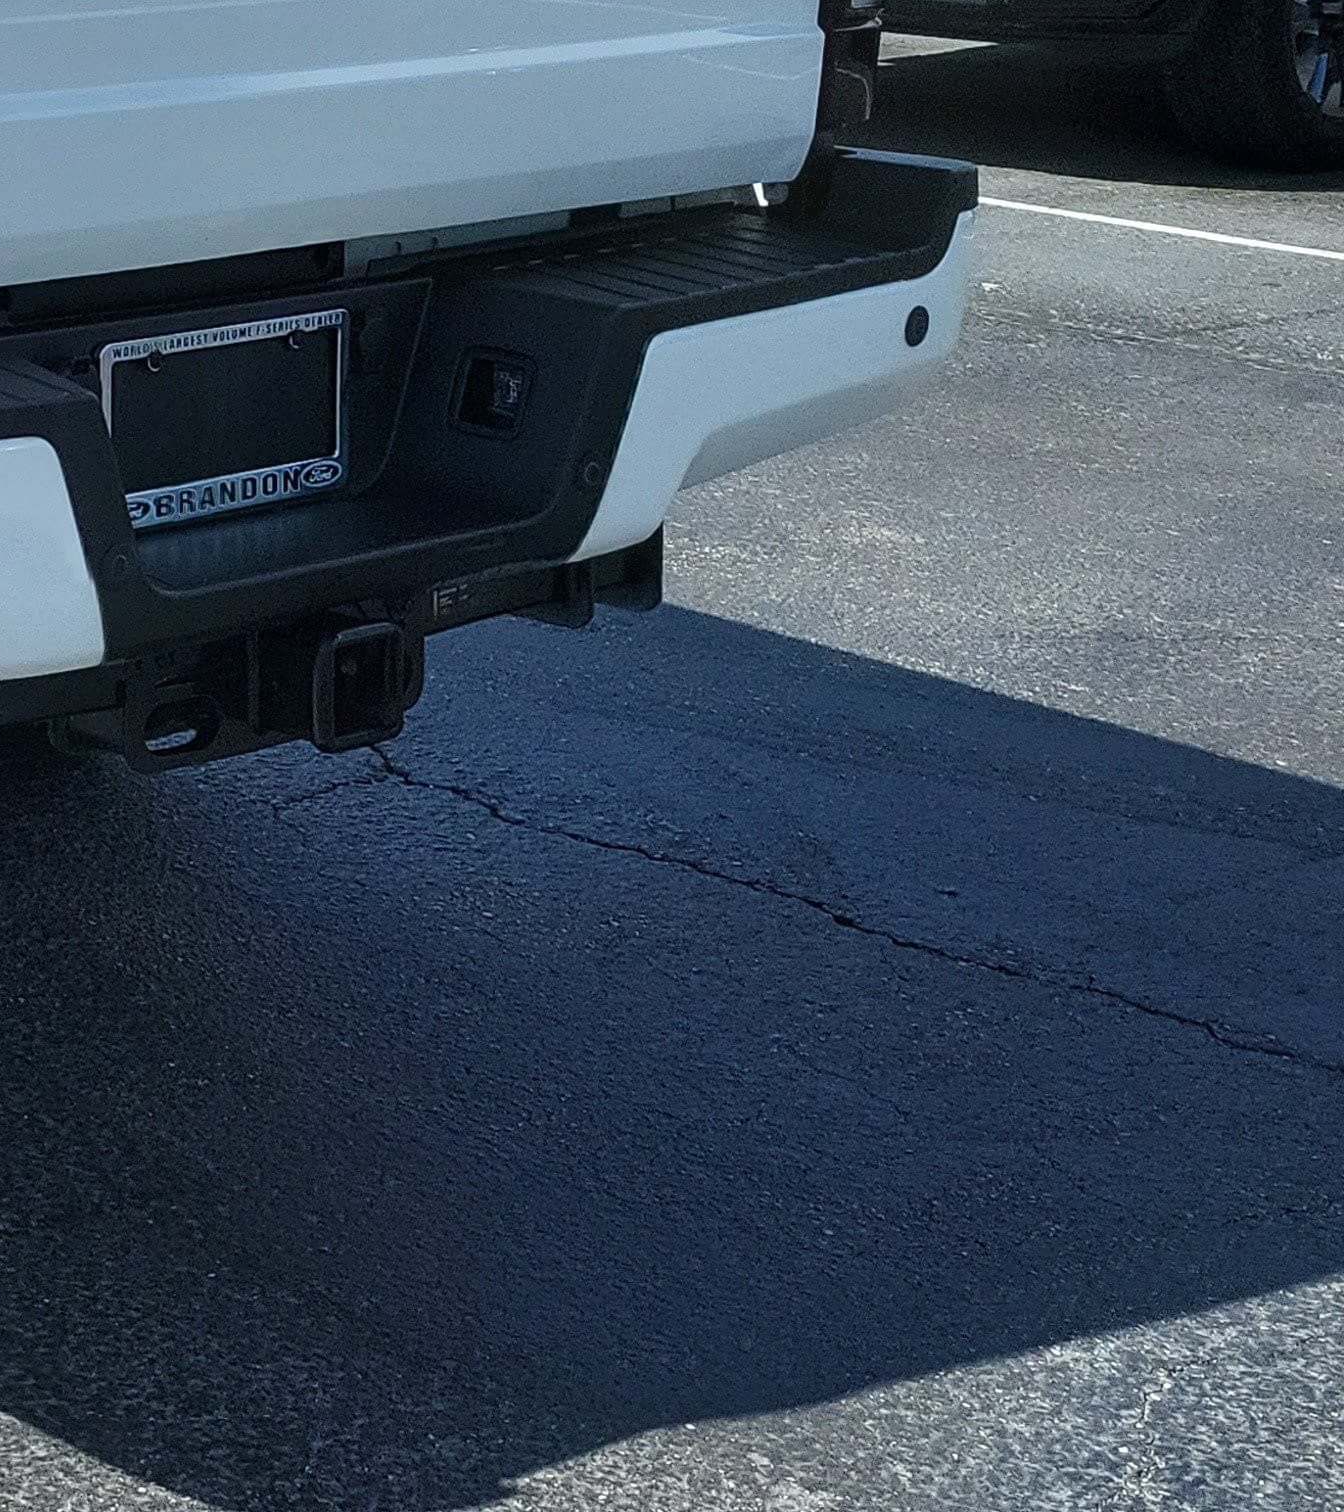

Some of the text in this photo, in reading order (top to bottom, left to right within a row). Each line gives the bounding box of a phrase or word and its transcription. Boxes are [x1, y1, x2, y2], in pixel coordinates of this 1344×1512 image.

[162, 333, 209, 351] LARGEST
[212, 326, 252, 343] VOLUME
[304, 312, 342, 329] DEALER
[153, 466, 302, 518] BRANDON
[308, 468, 334, 482] Ford
